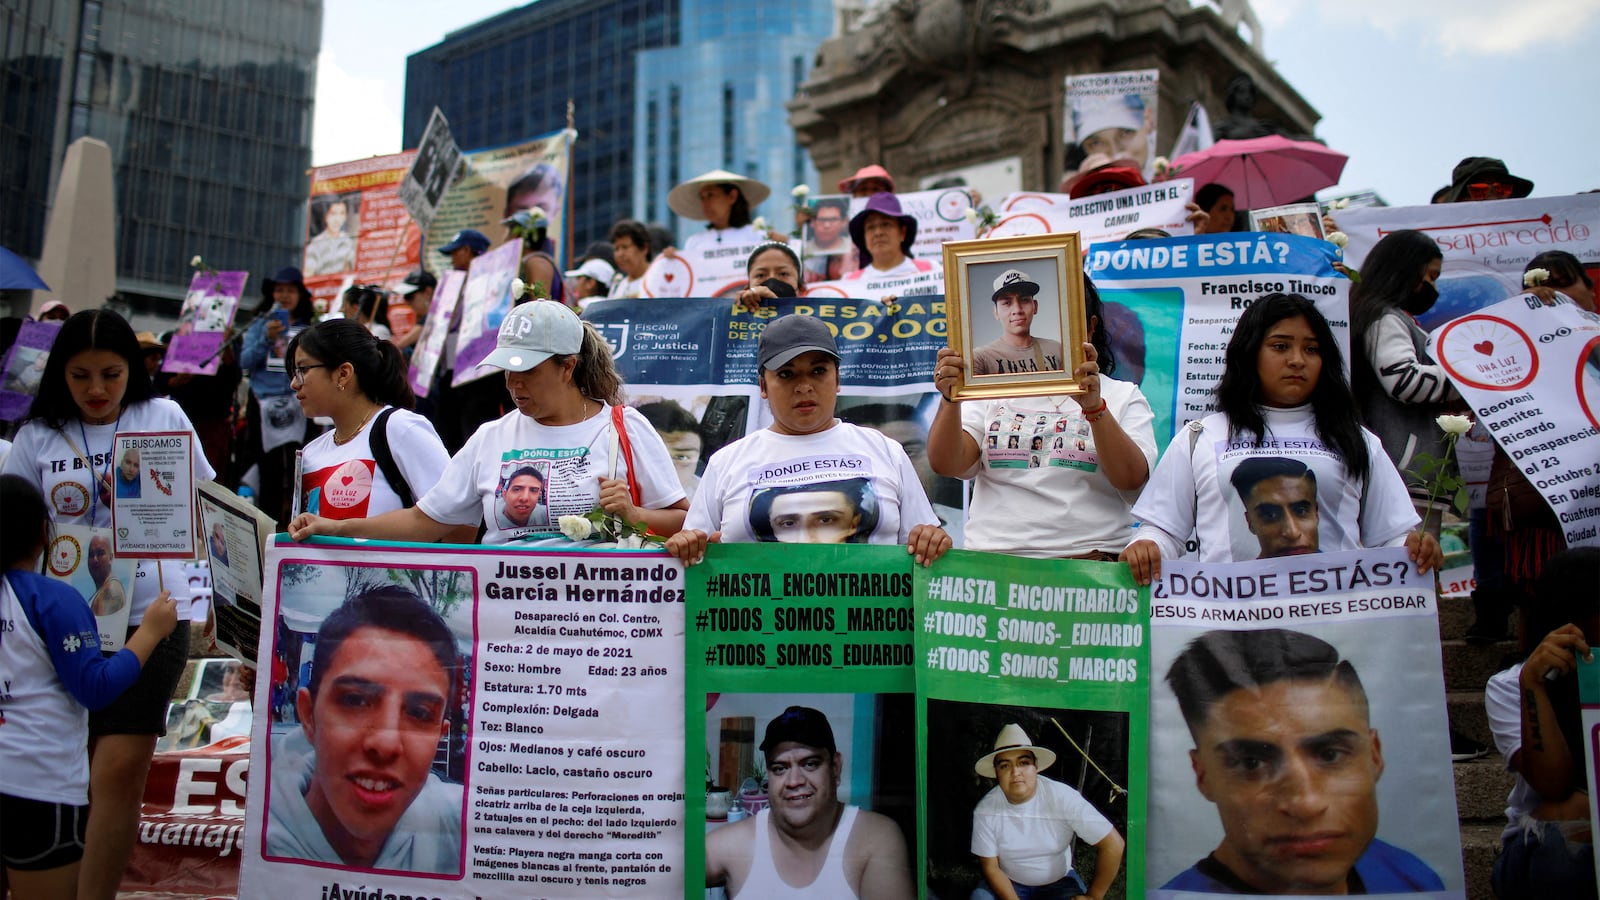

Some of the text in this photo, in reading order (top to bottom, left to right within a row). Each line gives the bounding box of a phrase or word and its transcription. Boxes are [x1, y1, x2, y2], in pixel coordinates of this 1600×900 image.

[1070, 187, 1179, 218] COLECTIVO UNA LUZ EN EL
[1104, 213, 1139, 228] CAMINO
[1437, 219, 1589, 254] saparecid@
[1198, 235, 1290, 266] ESTÁ?
[867, 278, 911, 289] COLECTIVO
[1201, 278, 1336, 295] Francisco Tinoco
[635, 323, 678, 332] Fiscalía
[634, 332, 679, 341] General
[728, 332, 744, 340] DE
[651, 342, 698, 350] Justicia
[1184, 403, 1203, 411] Tez:
[1478, 392, 1535, 418] Geovani
[1489, 407, 1543, 432] Benitez
[1500, 420, 1555, 447] Ricardo
[122, 439, 182, 448] TE BUSCAMOS
[51, 460, 66, 473] TE
[815, 458, 862, 469] ESTÁS?
[1525, 456, 1560, 475] el 23
[1536, 467, 1592, 490] Octubre
[1547, 494, 1568, 505] En
[1567, 525, 1596, 543] Ciudad
[496, 562, 677, 581] Jussel Armando
[707, 573, 912, 600] #HASTA_ENCONTRARLOS
[1154, 560, 1408, 600] ¿DÓNDE ESTÁS?
[486, 583, 685, 603] García Hernández
[928, 576, 1138, 613] #HASTA_ENCONTRARLOS
[1150, 596, 1426, 622] JESUS ARMANDO REYES ESCOBAR
[515, 611, 579, 623] Desapareció
[599, 614, 619, 623] Col.
[623, 614, 660, 624] Centro,
[696, 607, 914, 634] #TODOS_SOMOS_MARCOS
[515, 625, 663, 638] Alcaldía Cuahutémoc, CDMX
[487, 643, 633, 658] Fecha: 2 de mayo de 2021
[705, 644, 914, 669] #TODOS_SOMOS_EDUARDO
[484, 662, 667, 676] Sexo: Hombre Edad: 23 años
[928, 647, 1137, 683] #TODOS_SOMOS_MARCOS
[484, 682, 587, 696] Estatura: 1.70 mts
[483, 702, 599, 719] Complexión: Delgada
[481, 721, 543, 734] Tez: Blanco
[479, 742, 645, 758] Ojos: Medianos y café oscuro
[478, 762, 652, 779] Cabello: Lacio, castaño oscuro
[477, 786, 505, 796] Señas
[508, 788, 568, 799] particulares:
[572, 791, 639, 801] Perforaciones
[643, 793, 653, 801] en
[475, 800, 645, 816] cicatriz arriba de la ceja izquierda,
[475, 813, 677, 829] 2 tatuajes en el pecho: del lado izquierdo
[495, 827, 535, 837] calavera
[539, 831, 543, 839] y
[547, 830, 561, 839] del
[564, 831, 603, 839] derecho
[474, 846, 506, 855] Vestía:
[509, 848, 544, 859] Playera
[548, 851, 575, 860] negra
[579, 852, 612, 861] manga
[616, 852, 642, 860] corta
[522, 862, 560, 872] blancas
[563, 864, 572, 872] al
[575, 864, 607, 874] frente,
[611, 864, 655, 874] pantalón
[659, 865, 671, 873] de
[473, 872, 646, 887] mezclilla azul oscuro y tenis negros
